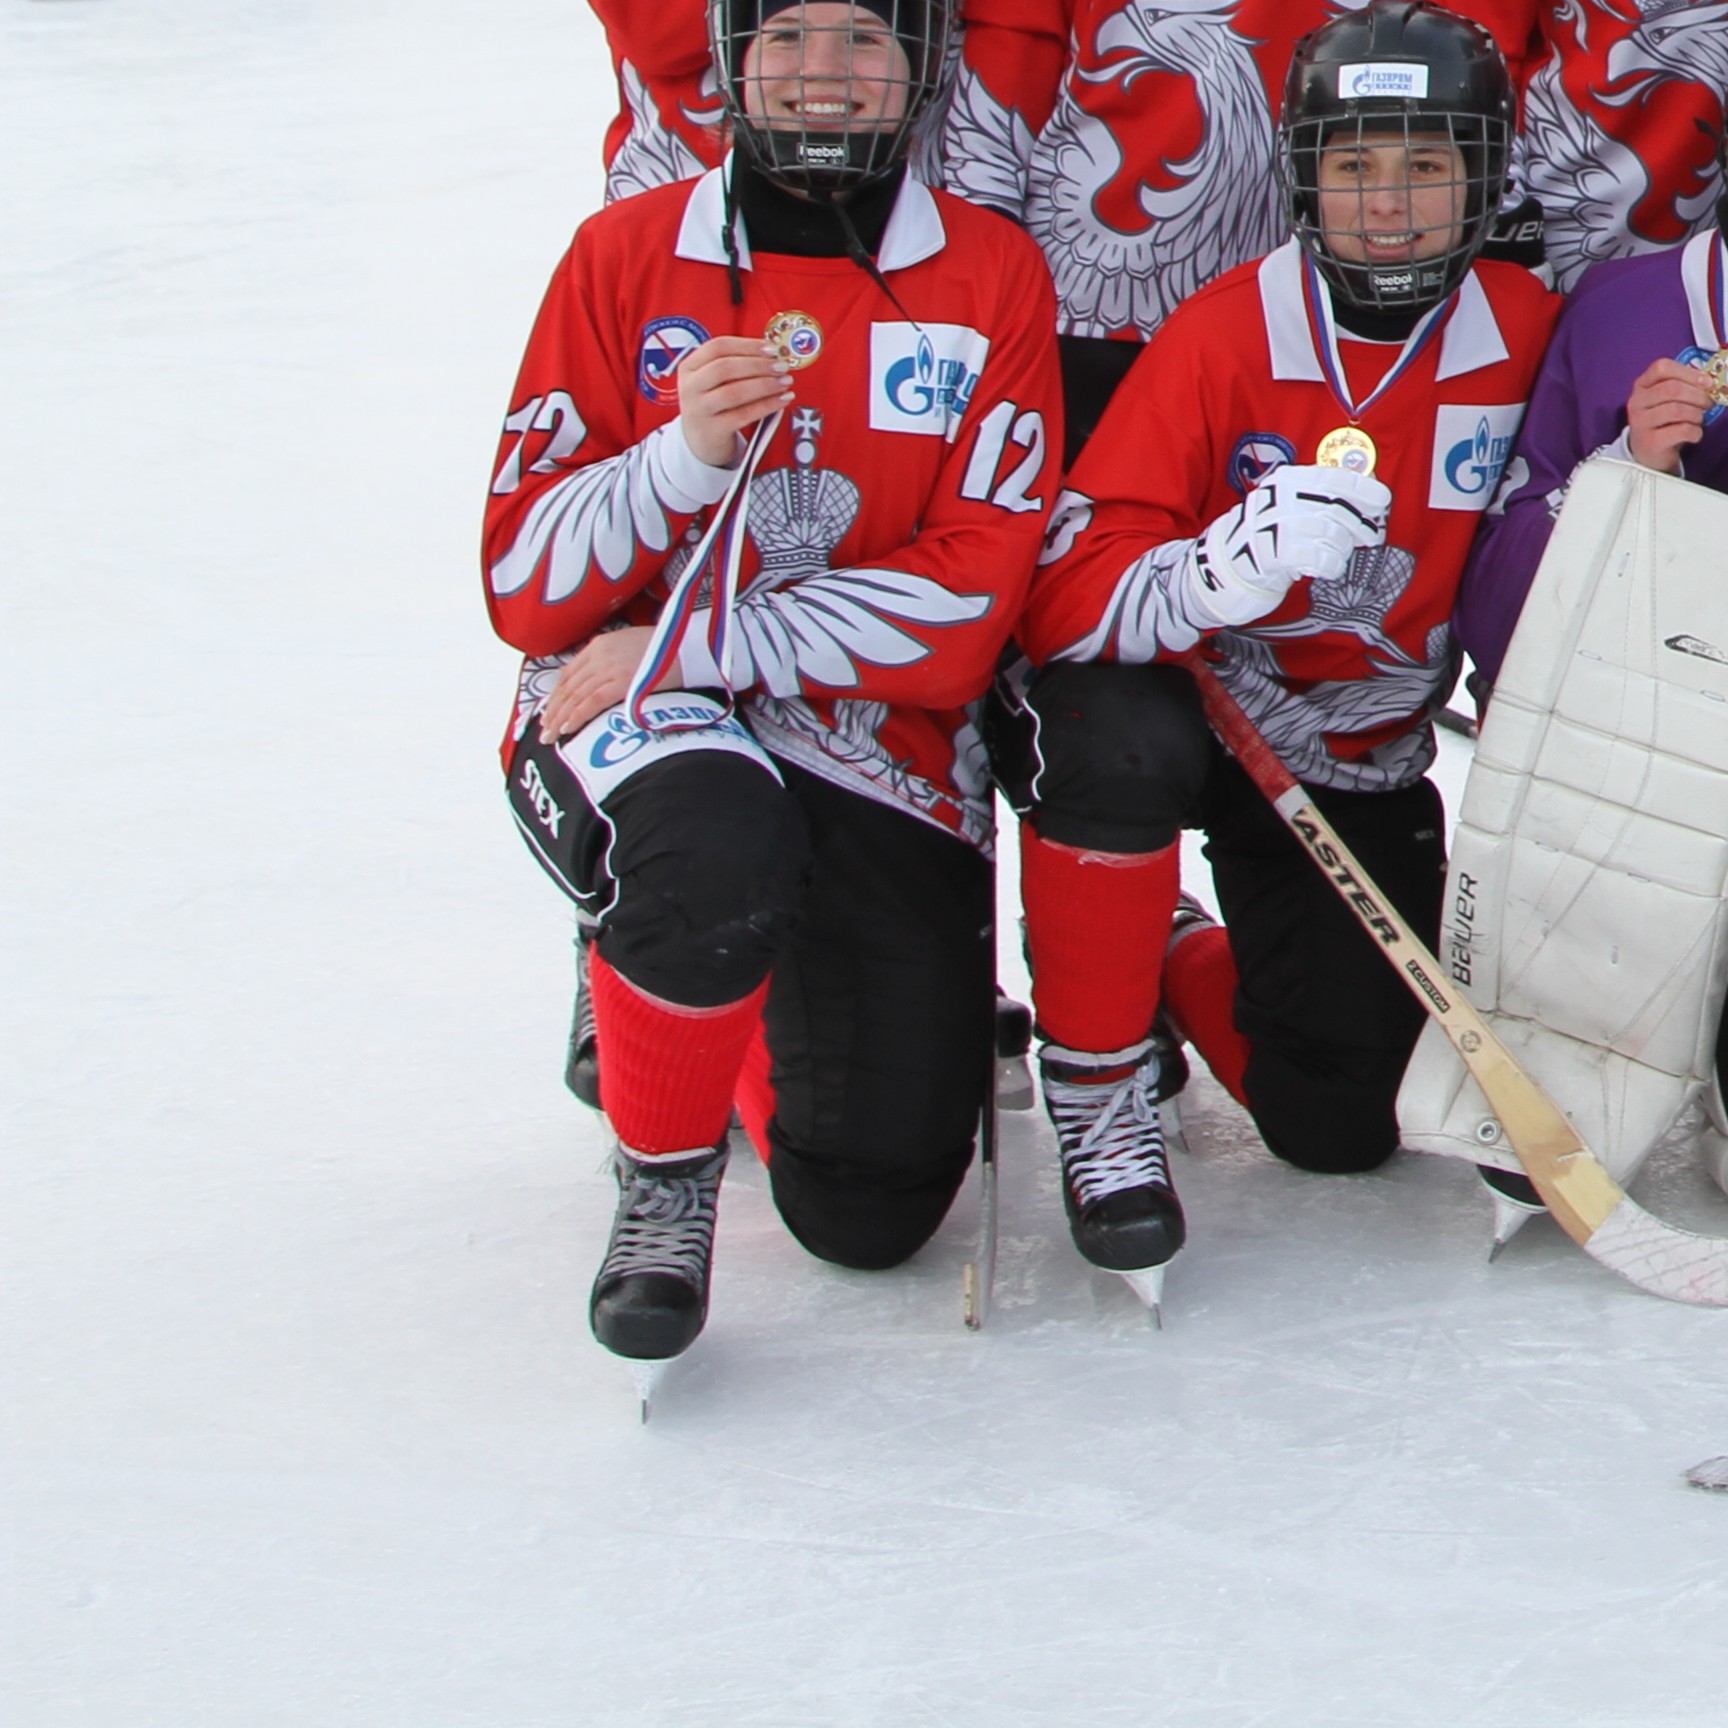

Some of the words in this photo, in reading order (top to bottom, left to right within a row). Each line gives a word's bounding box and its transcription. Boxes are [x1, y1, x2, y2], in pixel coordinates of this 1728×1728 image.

[960, 400, 1045, 513] 12
[519, 758, 566, 840] STEX
[1291, 809, 1401, 947] ASTER
[1451, 871, 1480, 989] BAUER
